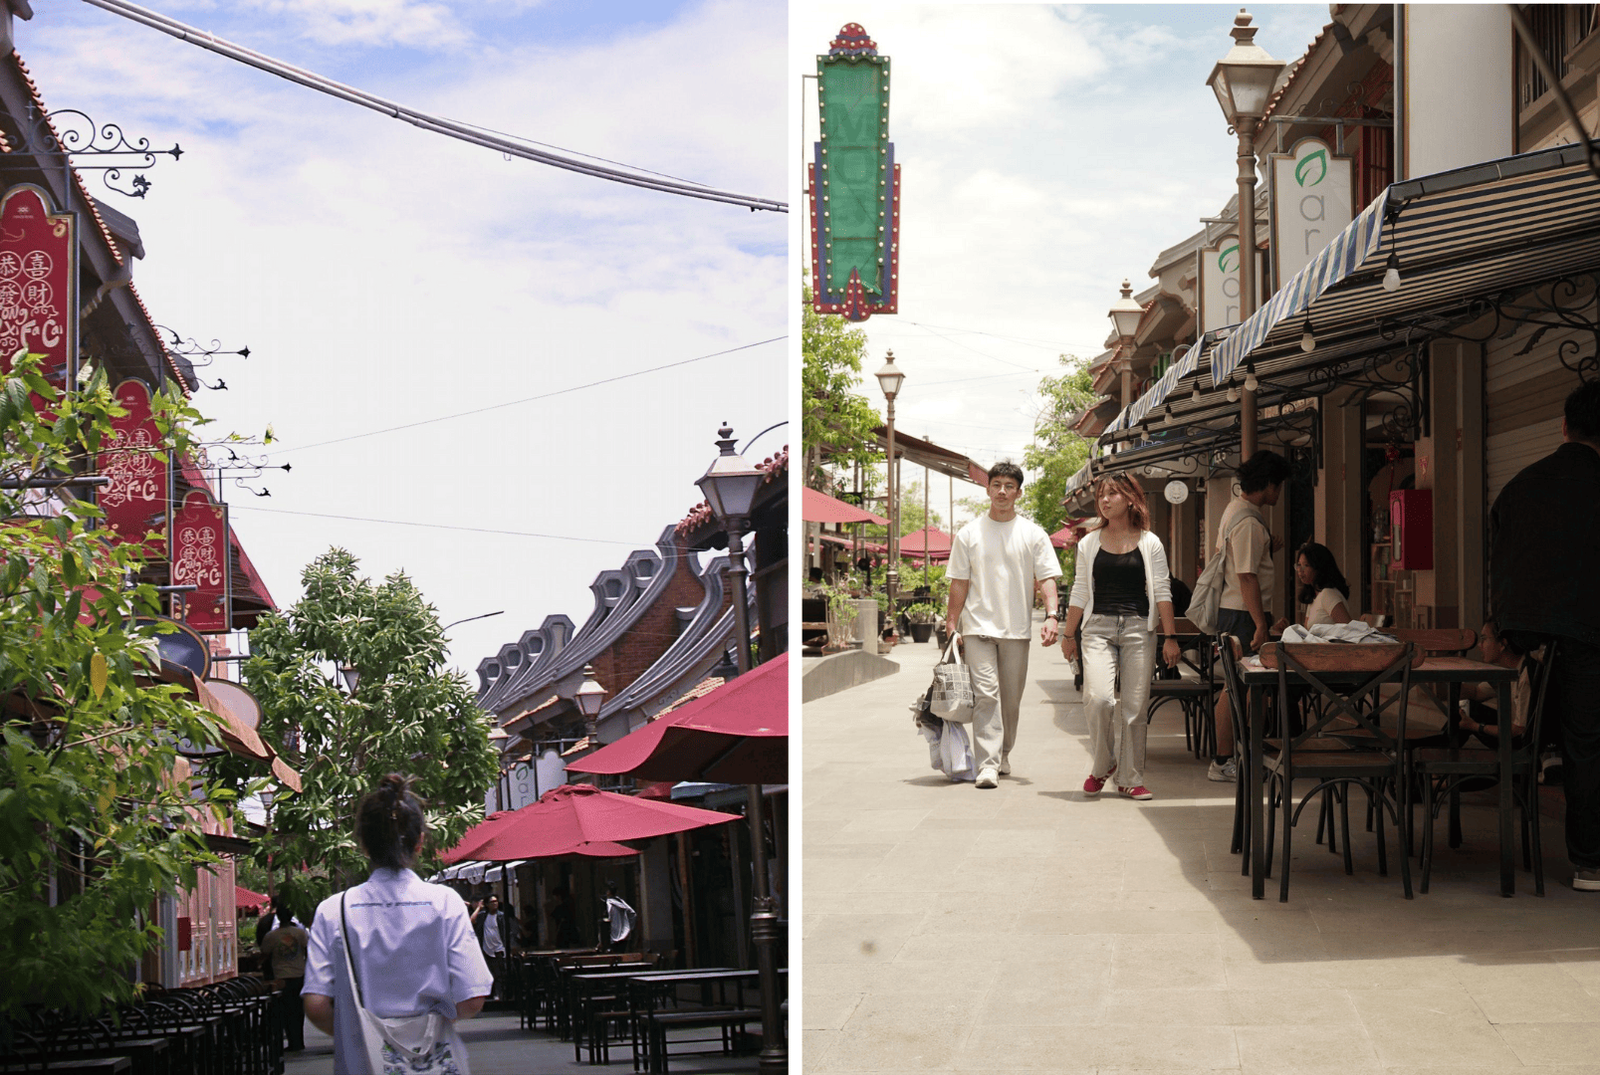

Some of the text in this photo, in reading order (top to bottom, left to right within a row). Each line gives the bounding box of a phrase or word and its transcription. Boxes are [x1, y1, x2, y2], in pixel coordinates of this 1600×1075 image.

[0, 305, 28, 326] ong
[20, 319, 40, 348] Fa
[42, 319, 63, 348] Cai
